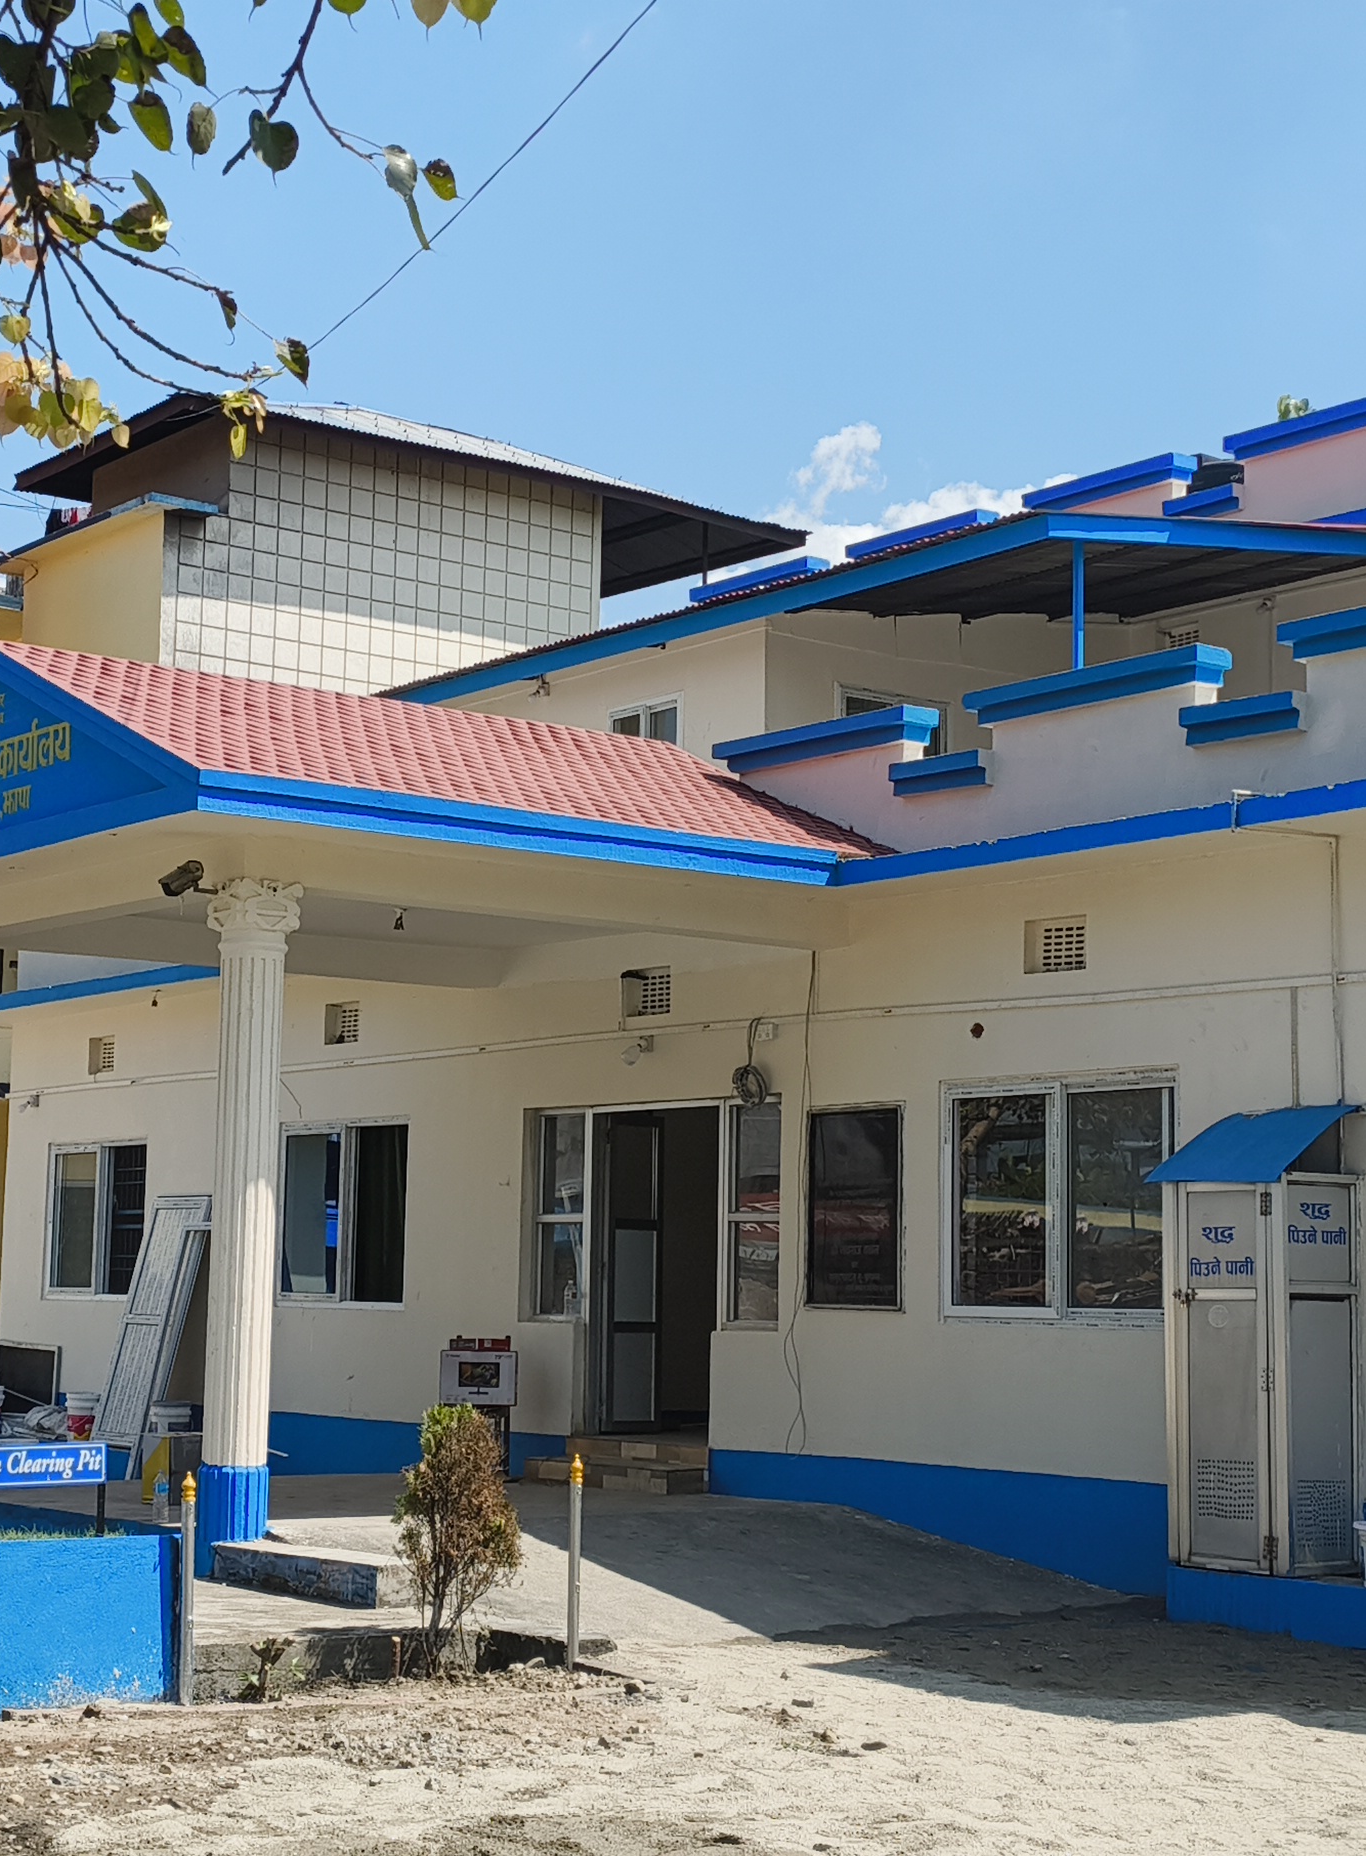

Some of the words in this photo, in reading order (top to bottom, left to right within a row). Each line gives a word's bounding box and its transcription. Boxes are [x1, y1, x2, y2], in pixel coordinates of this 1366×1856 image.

[1288, 1225, 1317, 1245] पिउने
[1321, 1227, 1348, 1246] पानी
[1190, 1256, 1221, 1277] पिउने
[1225, 1256, 1255, 1276] पानी
[6, 1451, 75, 1479] Clearing
[76, 1449, 103, 1472] Pit
